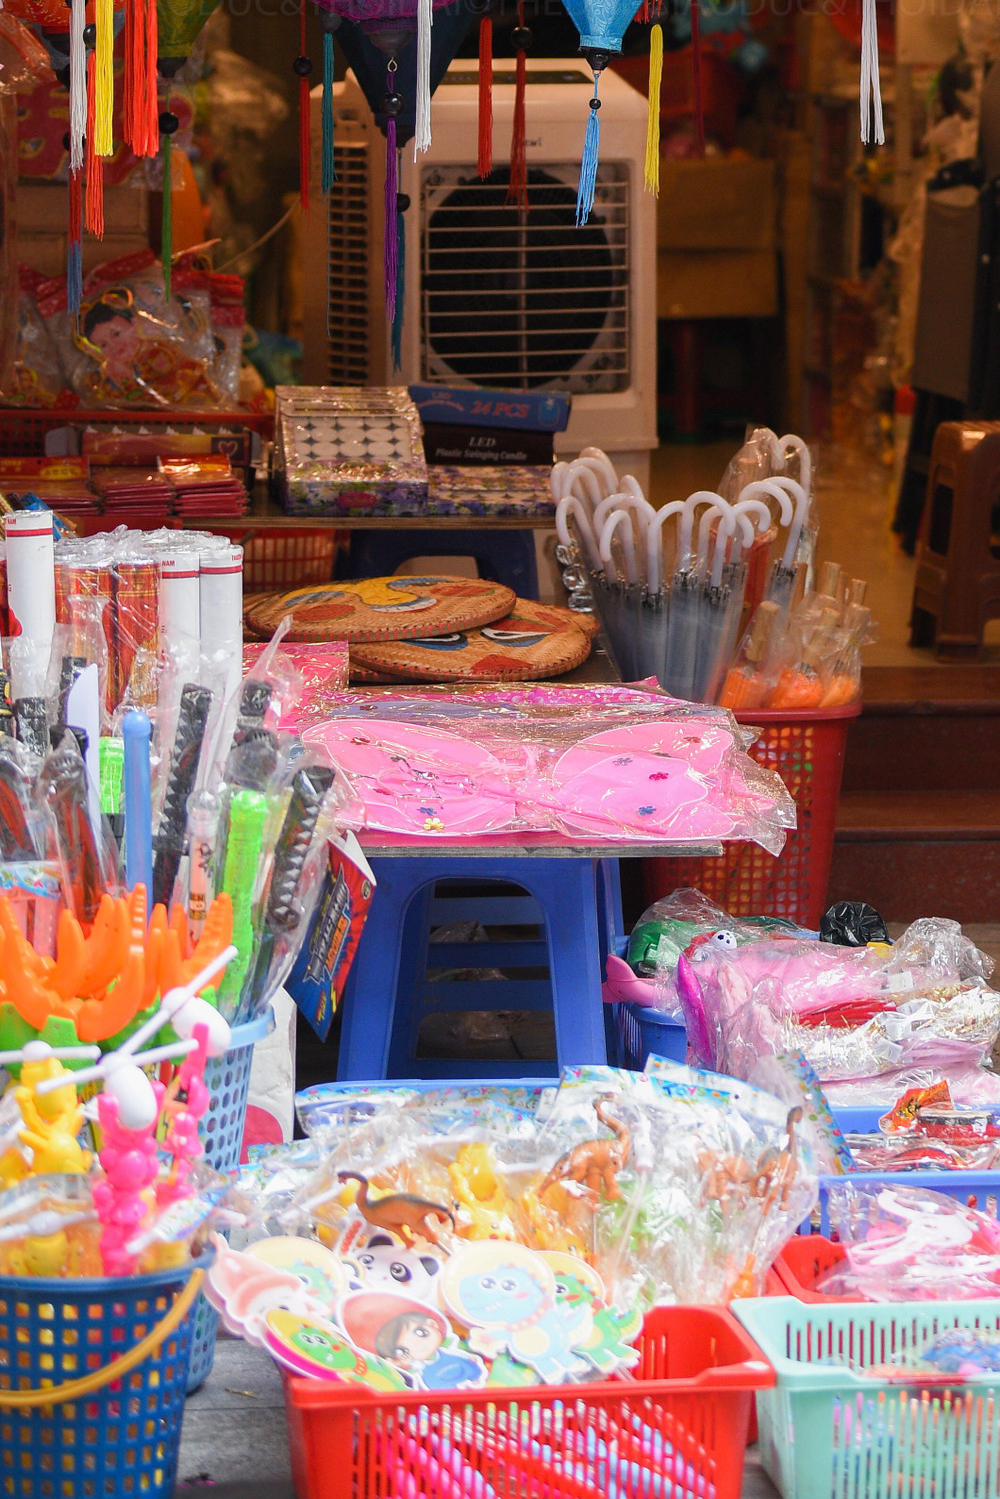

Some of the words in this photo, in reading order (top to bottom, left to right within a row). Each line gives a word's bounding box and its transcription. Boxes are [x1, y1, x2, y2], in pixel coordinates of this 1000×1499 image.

[471, 400, 491, 416] 24
[492, 402, 531, 419] PCS
[468, 436, 497, 448] LED
[435, 448, 462, 458] Plastic
[464, 449, 499, 462] Swinging
[500, 450, 527, 460] Candle
